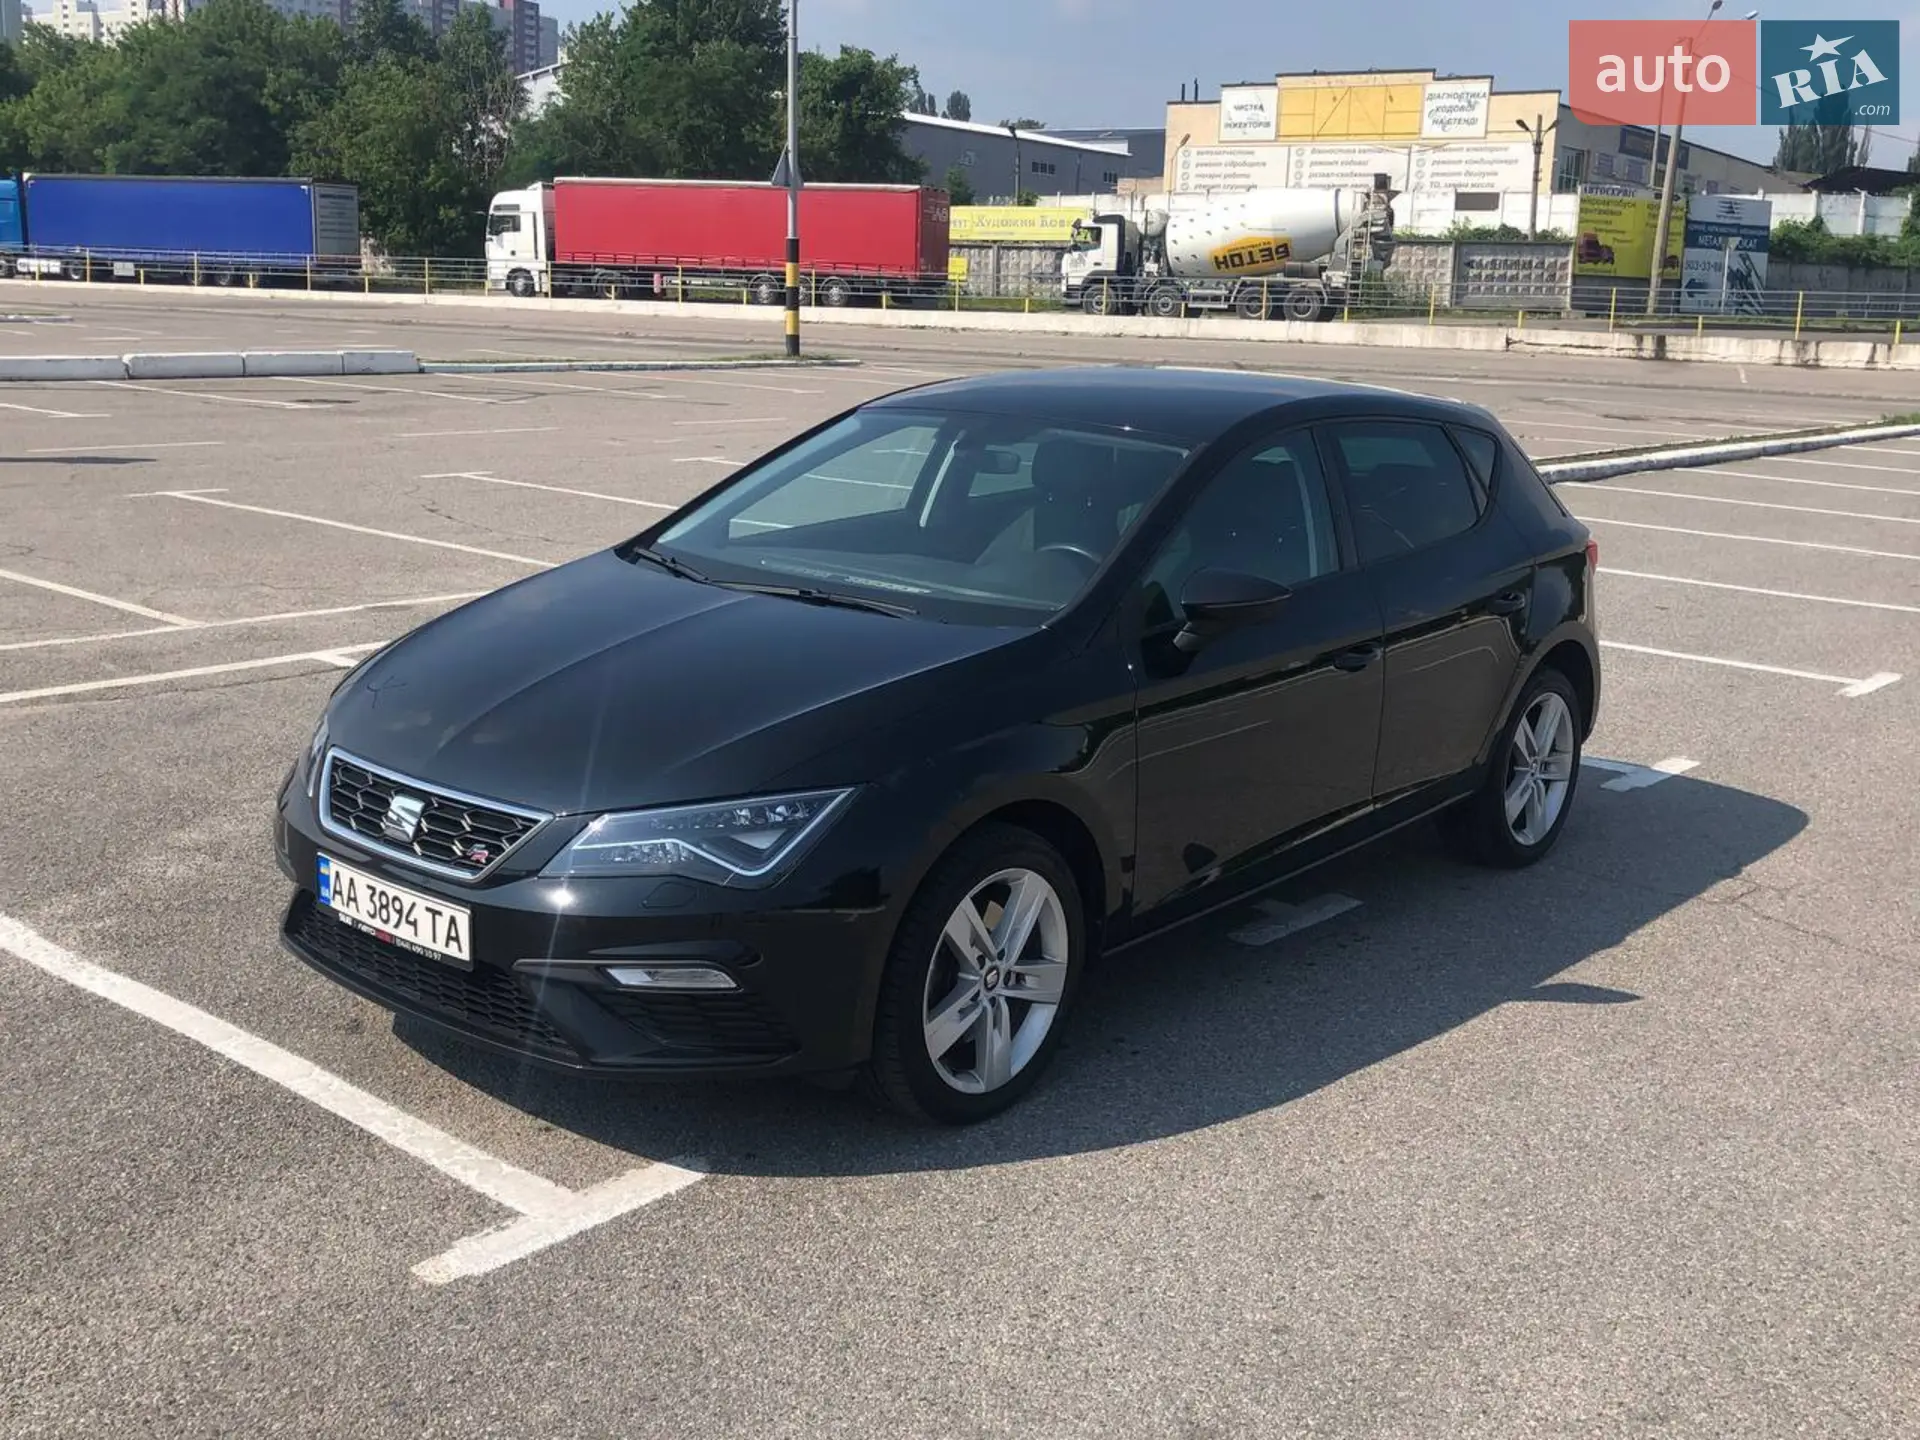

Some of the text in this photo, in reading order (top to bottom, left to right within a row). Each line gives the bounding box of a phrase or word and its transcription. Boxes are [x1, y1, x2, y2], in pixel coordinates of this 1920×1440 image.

[1213, 243, 1290, 270] БЕТОН
[332, 871, 360, 913] AA
[366, 885, 418, 937] 3894
[425, 907, 462, 953] TA
